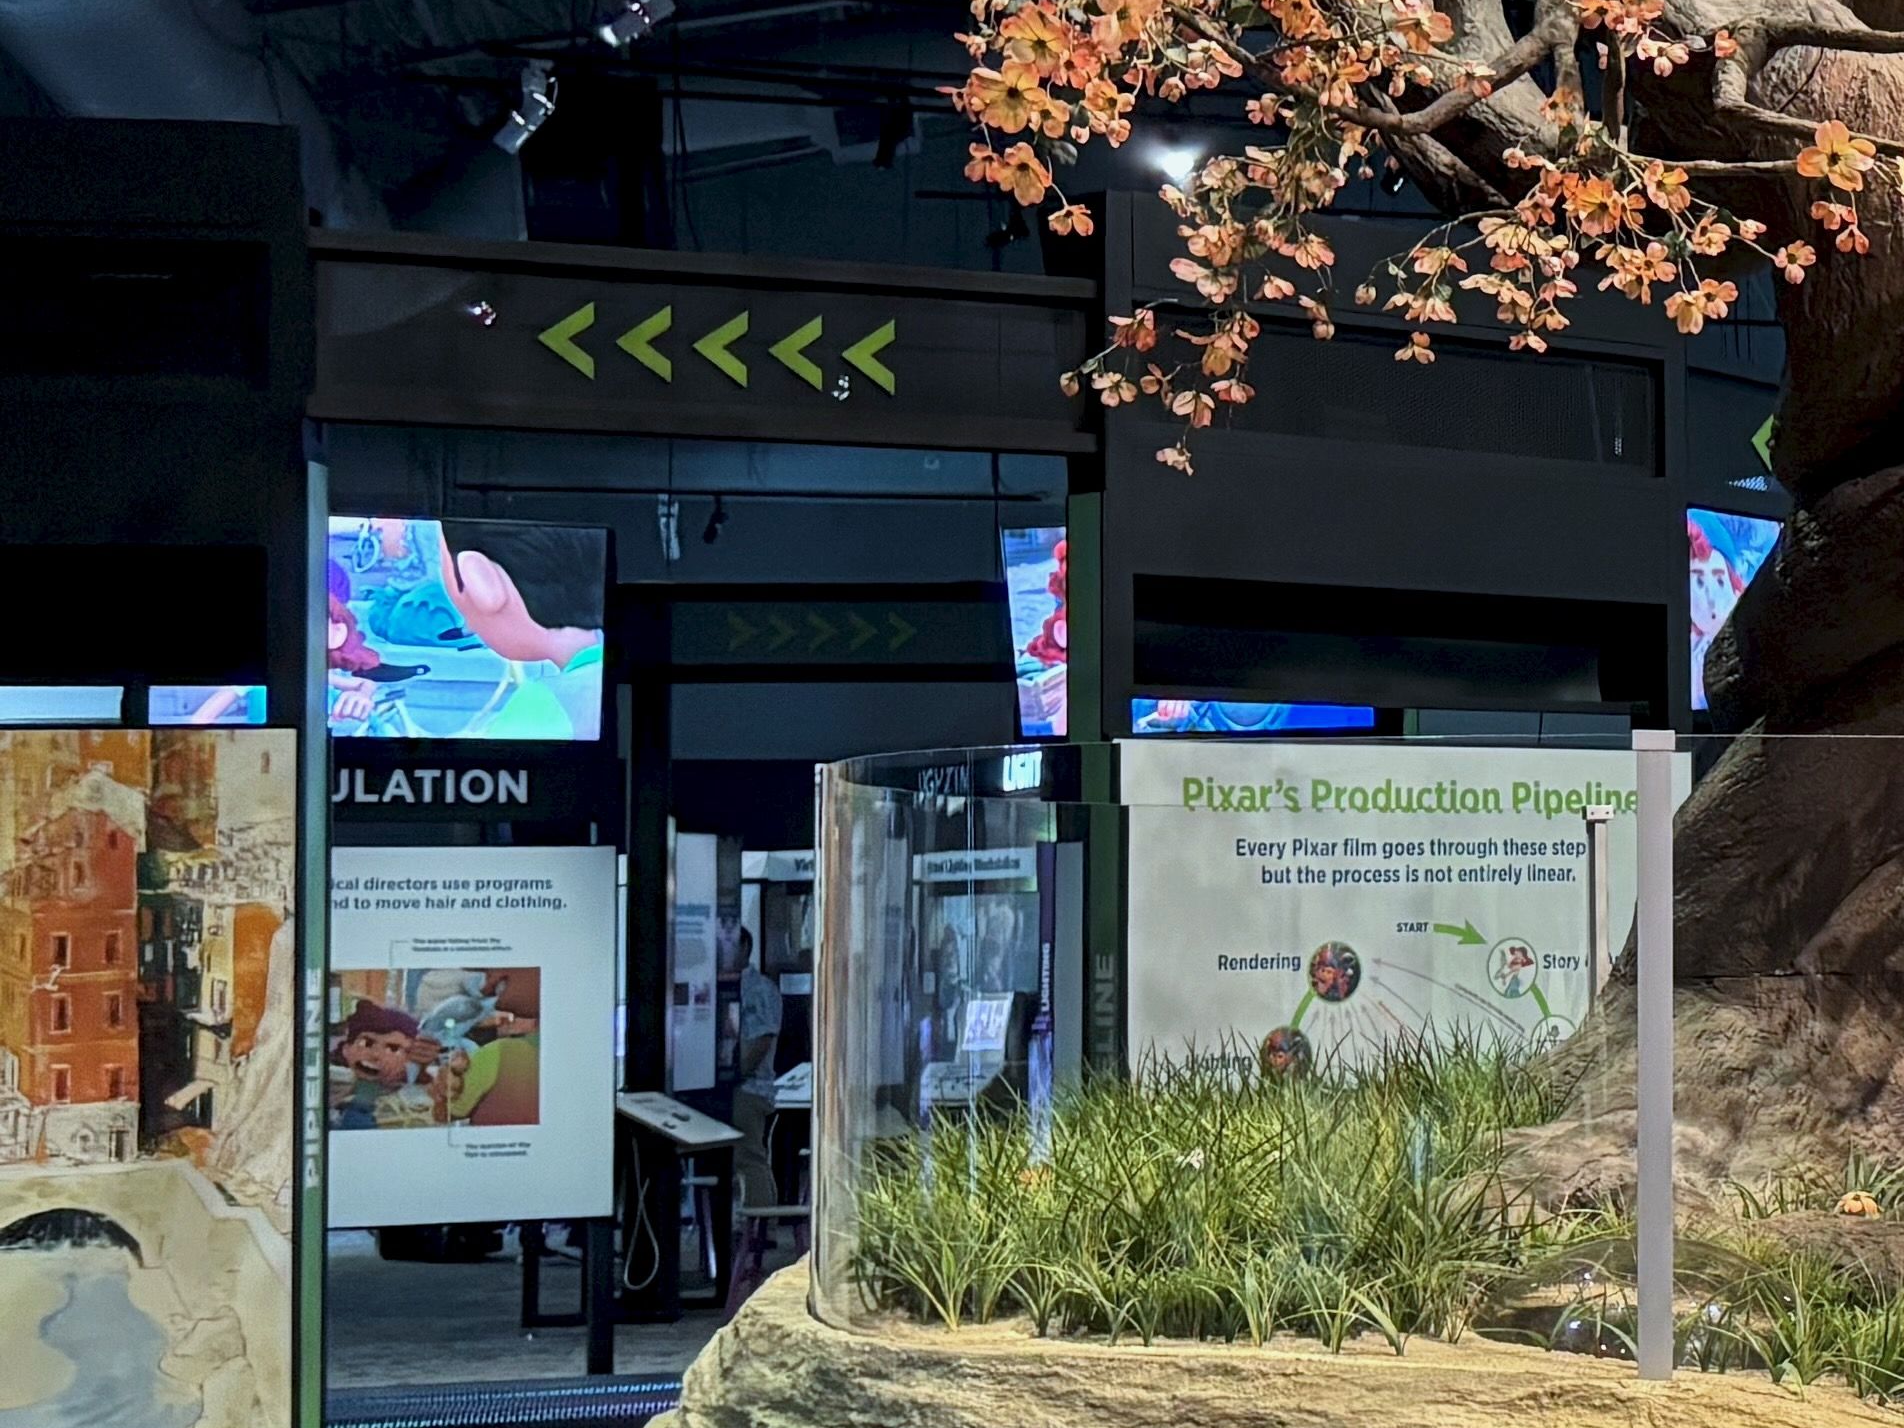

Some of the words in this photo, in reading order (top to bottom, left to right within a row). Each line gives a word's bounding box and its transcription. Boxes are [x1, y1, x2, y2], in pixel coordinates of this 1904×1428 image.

[1183, 776, 1302, 813] Pixar's
[1311, 778, 1503, 814] Production
[1512, 780, 1638, 820] Pipeline
[1235, 838, 1287, 860] Every
[1292, 837, 1338, 857] Pixar
[1343, 837, 1377, 857] film
[1382, 841, 1425, 860] goes
[1429, 837, 1498, 859] through
[1503, 837, 1548, 856] these
[363, 876, 438, 891] directors
[442, 879, 471, 891] use
[474, 878, 553, 894] programs
[1261, 865, 1292, 884] but
[1297, 865, 1327, 884] the
[1332, 868, 1401, 887] process
[1405, 865, 1419, 883] is
[1424, 866, 1453, 883] not
[1457, 863, 1523, 885] entirely
[1527, 865, 1576, 883] linear.
[353, 897, 371, 910] to
[375, 899, 421, 910] move
[425, 896, 456, 909] hair
[460, 895, 492, 909] and
[495, 895, 568, 911] clothing.
[1396, 921, 1430, 934] START
[1217, 951, 1301, 975] Rendering
[1543, 953, 1581, 971] Story
[303, 968, 321, 1188] PIPELINE
